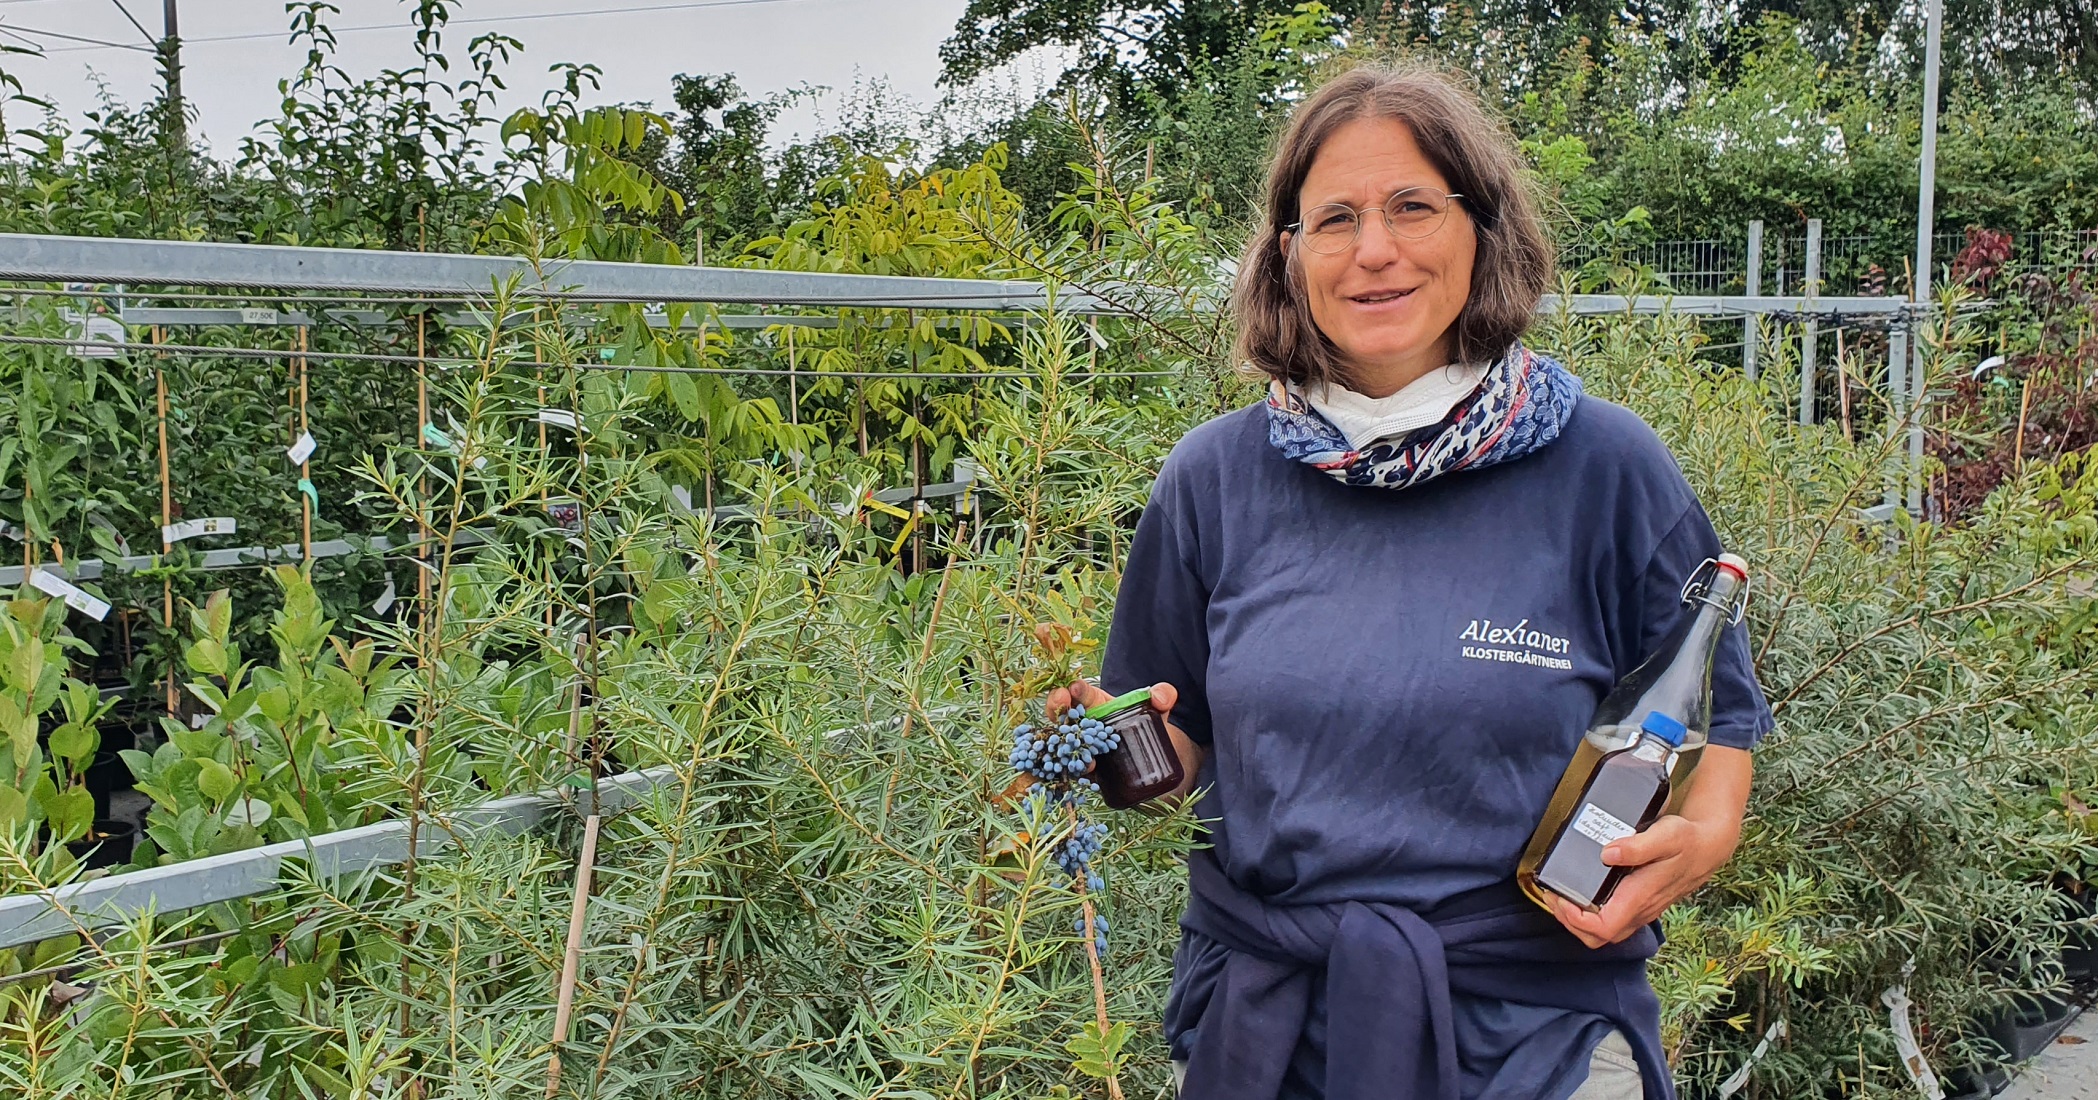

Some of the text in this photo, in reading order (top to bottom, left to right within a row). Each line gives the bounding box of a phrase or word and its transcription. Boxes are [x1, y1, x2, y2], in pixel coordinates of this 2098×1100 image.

[250, 311, 273, 321] 27,50€
[1459, 618, 1570, 654] Alexianer
[1462, 646, 1572, 670] KLOSTERGÄRTNEREI
